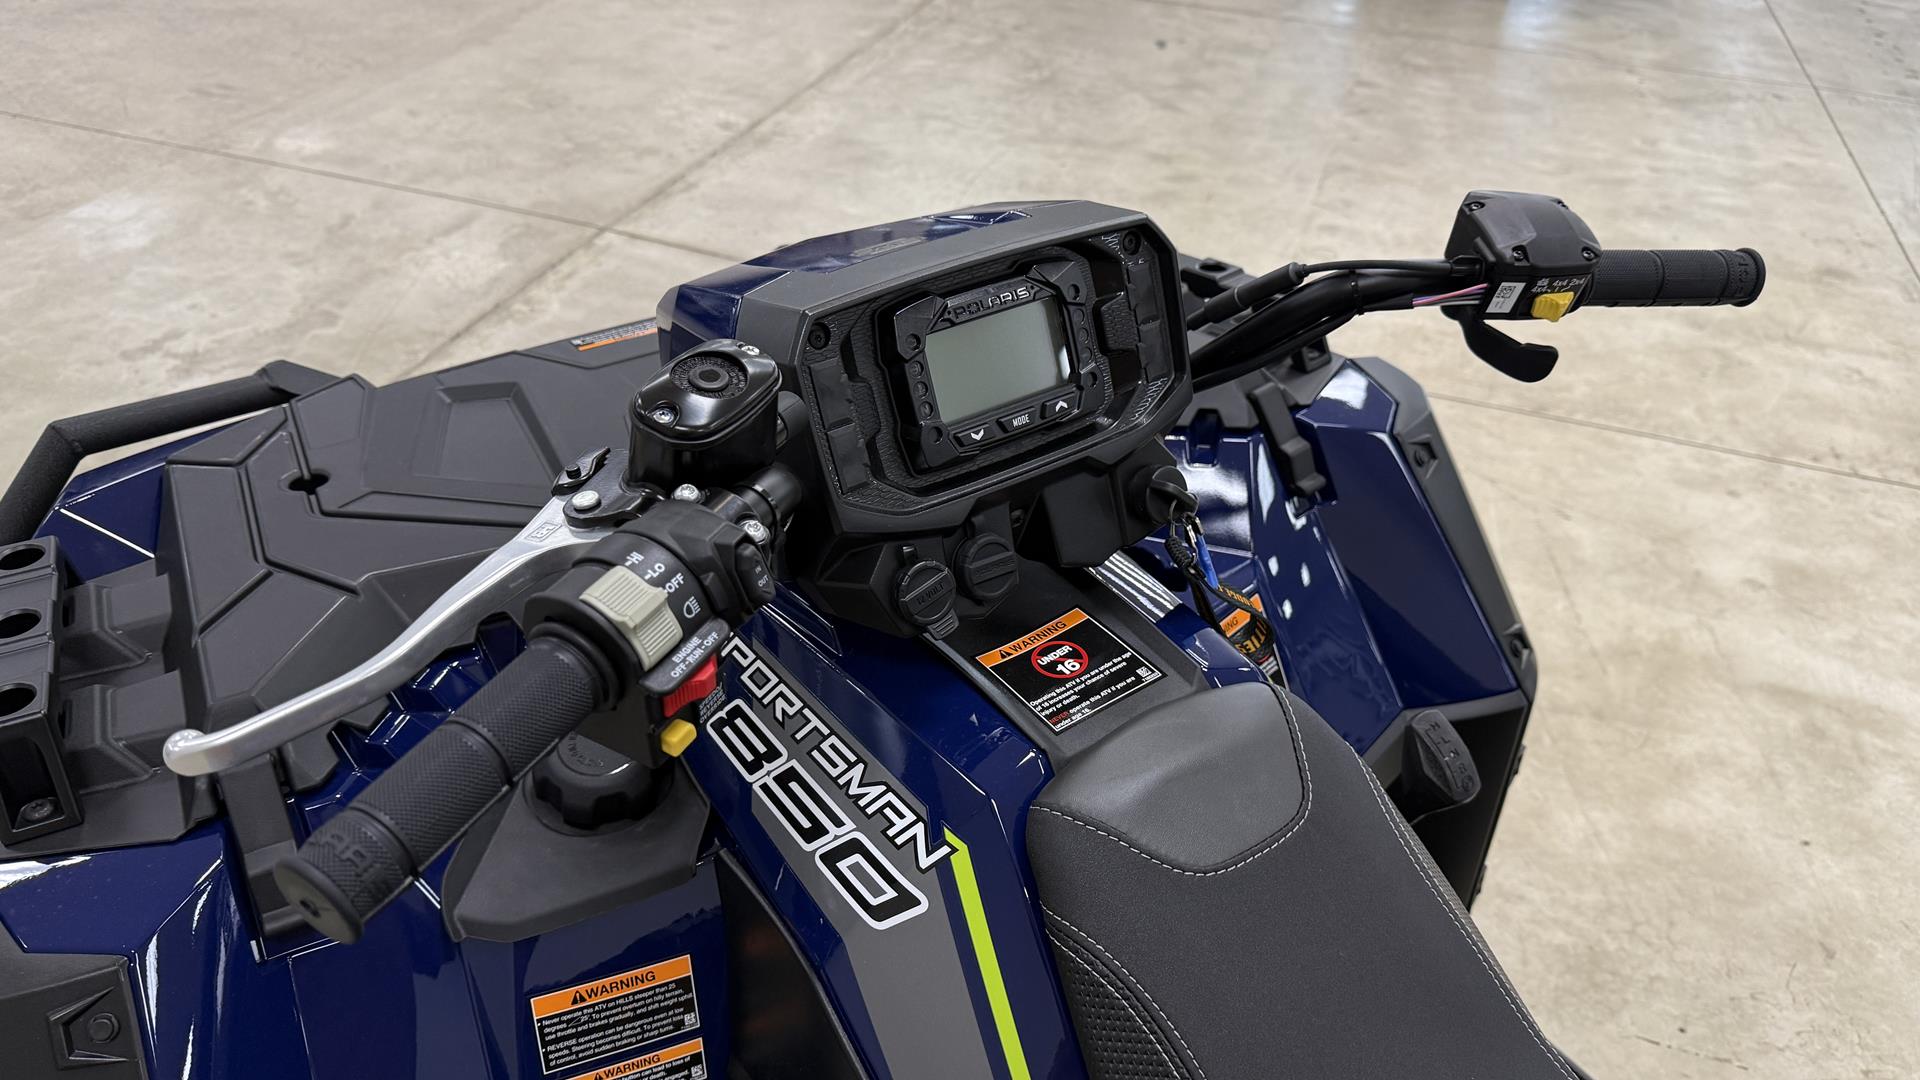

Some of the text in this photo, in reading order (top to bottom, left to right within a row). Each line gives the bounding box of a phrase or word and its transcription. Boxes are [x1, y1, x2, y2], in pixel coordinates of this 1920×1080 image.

[953, 286, 1030, 320] POLARIS
[1012, 413, 1030, 428] MODE
[757, 574, 769, 588] OUT
[672, 636, 702, 664] ENGINE
[1010, 621, 1067, 653] WARNING
[1037, 645, 1072, 665] UNDER
[1056, 659, 1081, 675] 16
[1030, 691, 1057, 706] Operating
[1065, 680, 1076, 688] ATV
[1098, 661, 1113, 671] under
[1048, 690, 1074, 704] increases
[1073, 683, 1085, 692] your
[1085, 674, 1104, 685] chance
[1110, 662, 1127, 672] severe
[1040, 706, 1056, 716] injury
[1062, 695, 1080, 705] death.
[1049, 711, 1069, 723] NEVER
[1069, 701, 1090, 713] operate
[1100, 688, 1111, 697] ATV
[1115, 681, 1126, 689] you
[1055, 718, 1071, 729] under
[721, 631, 952, 871] PORTSMAN
[706, 699, 929, 930] 850
[585, 971, 656, 999] WARNING
[542, 1017, 559, 1026] Never
[561, 1011, 582, 1020] operate
[595, 1003, 607, 1011] ATV
[616, 995, 633, 1005] HILLS
[634, 990, 654, 1000] steeper
[544, 1023, 567, 1033] degrees
[600, 1007, 621, 1018] prevent
[622, 1001, 645, 1011] overturn
[557, 1028, 576, 1037] throttle
[589, 1019, 608, 1028] brakes
[648, 1003, 659, 1011] shift
[660, 997, 677, 1007] weight
[547, 1039, 577, 1052] REVERSE
[578, 1031, 604, 1043] operation
[624, 1017, 653, 1029] dangerous
[571, 1042, 595, 1052] Steering
[596, 1034, 621, 1045] becomes
[652, 1018, 672, 1029] prevent
[579, 1049, 593, 1058] avoid
[595, 1043, 615, 1053] sudden
[615, 1037, 636, 1047] braking
[644, 1030, 659, 1038] sharp
[603, 1054, 661, 1080] WARNING
[652, 1064, 665, 1072] lead
